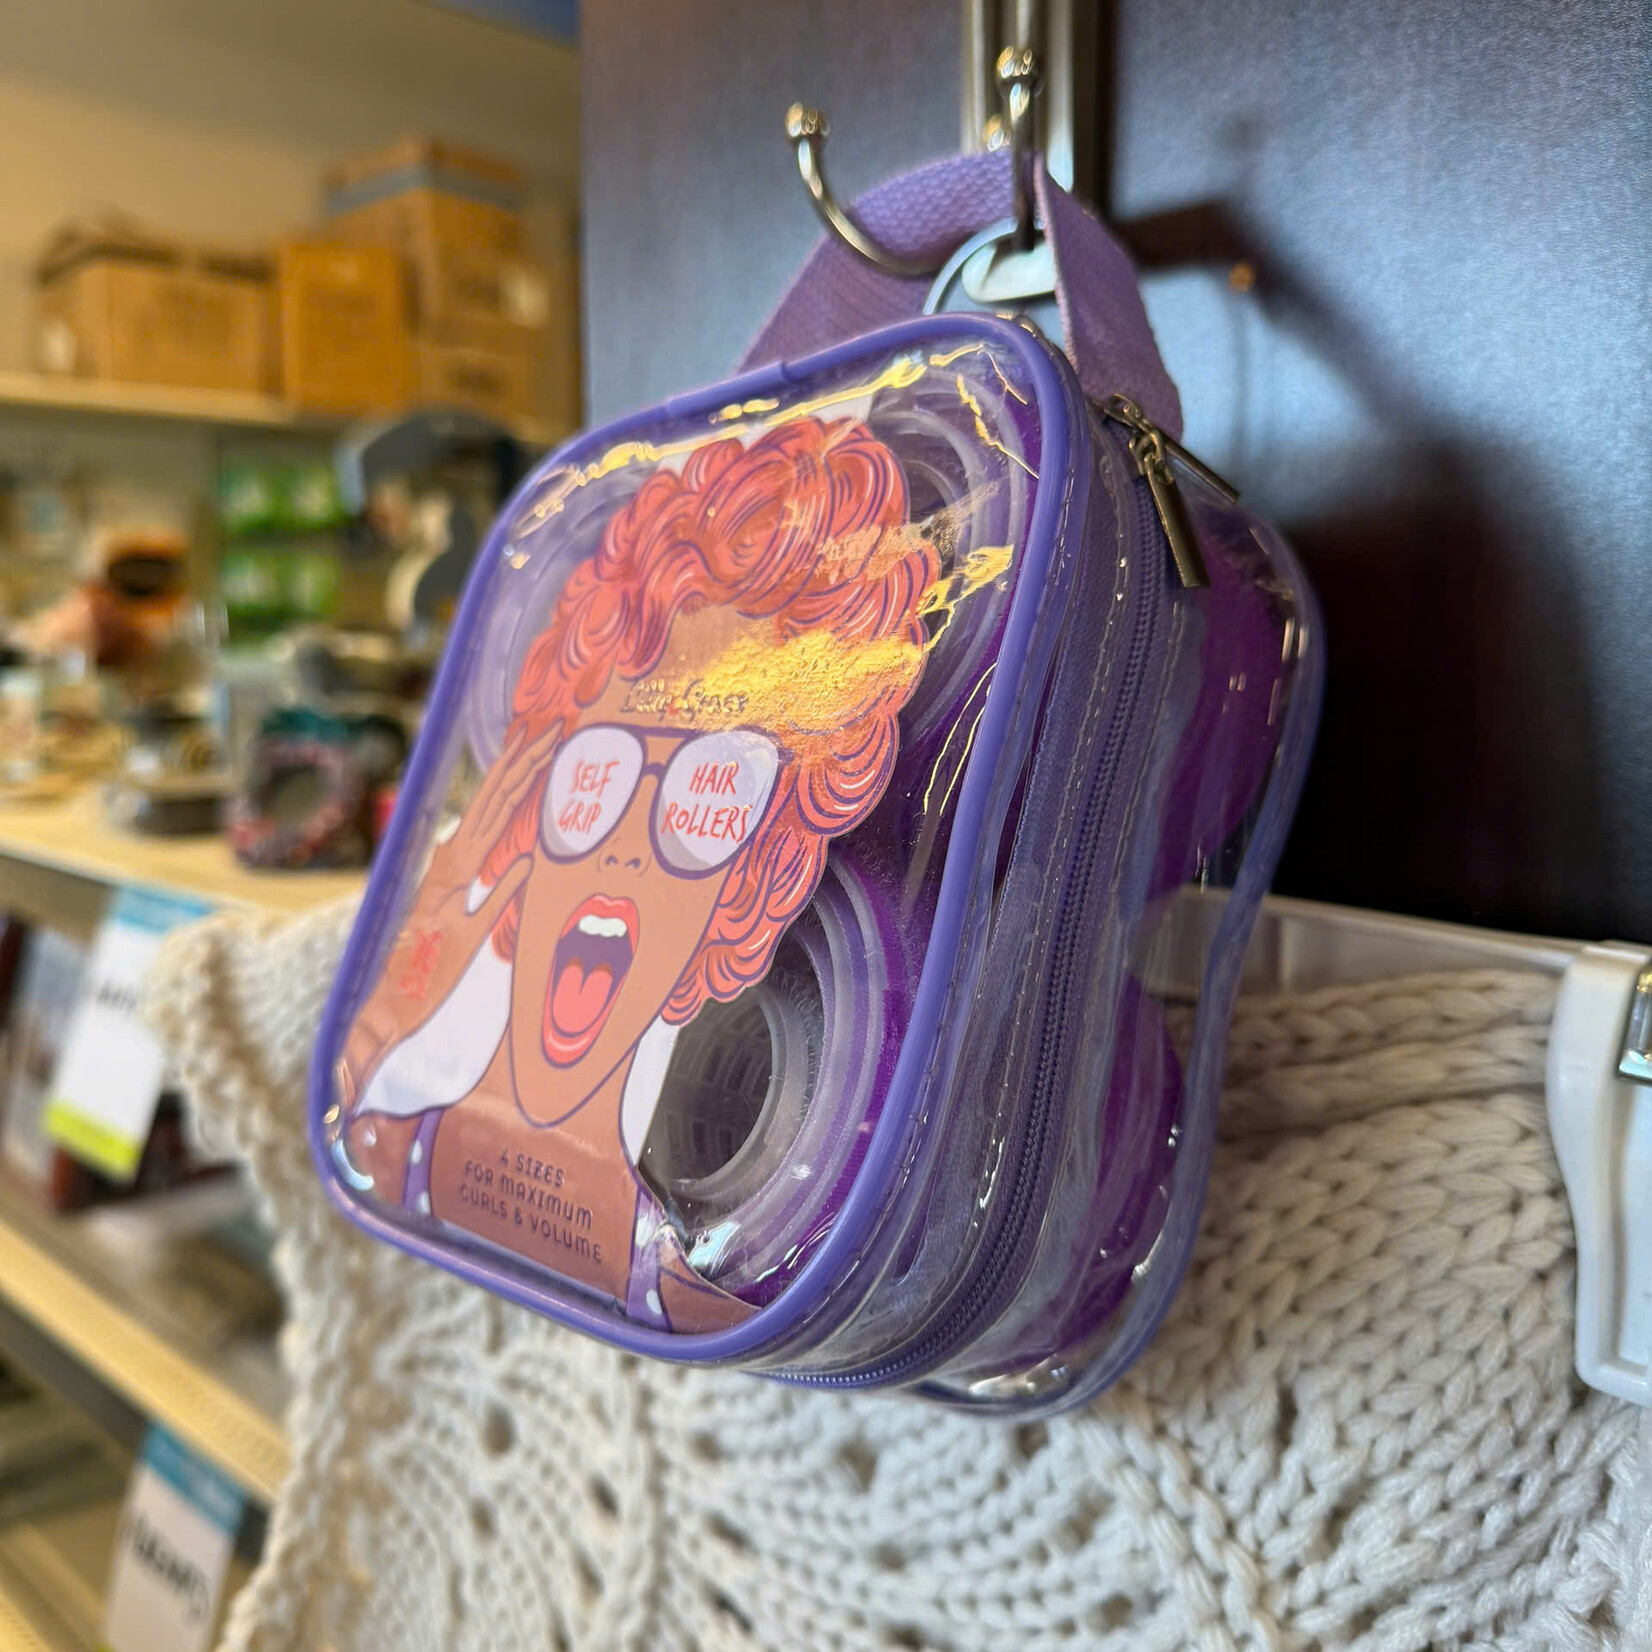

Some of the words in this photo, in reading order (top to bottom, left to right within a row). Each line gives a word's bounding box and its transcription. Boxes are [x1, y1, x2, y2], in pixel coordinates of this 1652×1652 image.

[570, 760, 620, 799] SELF
[688, 761, 739, 796] HAIR
[558, 799, 602, 835] GRIP
[660, 801, 753, 844] ROLLERS
[500, 1149, 509, 1168] 4
[516, 1153, 565, 1188] SIZES
[464, 1160, 494, 1186] FOR
[501, 1174, 594, 1230] MAXIMUM
[460, 1183, 508, 1218] CURLS
[514, 1206, 523, 1226] &
[530, 1214, 603, 1264] VOLUME
